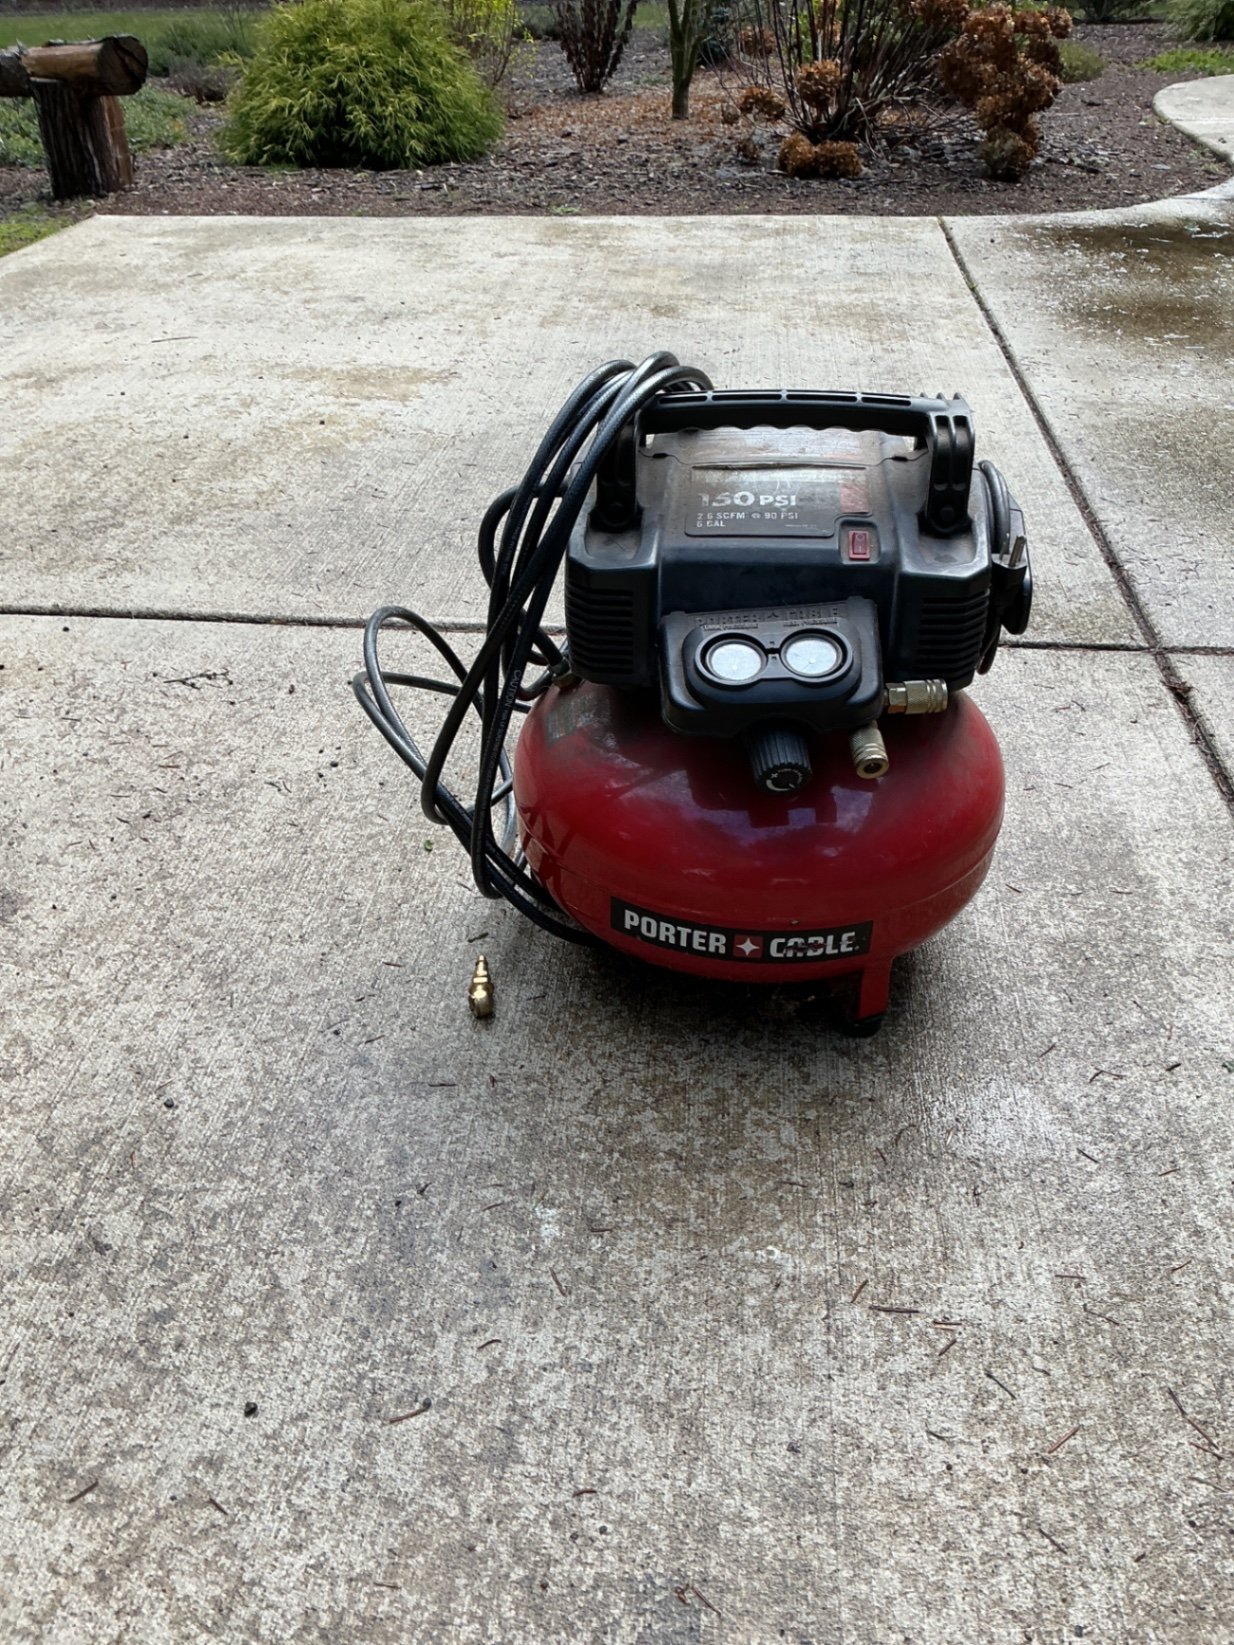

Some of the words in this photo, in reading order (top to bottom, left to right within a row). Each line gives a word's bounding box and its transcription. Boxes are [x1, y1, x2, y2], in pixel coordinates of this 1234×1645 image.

[759, 494, 797, 507] PSI
[716, 511, 746, 520] SCFM
[764, 512, 778, 520] 90
[781, 511, 799, 520] PSI
[504, 669, 522, 708] CAUTION
[624, 909, 727, 954] PORTER
